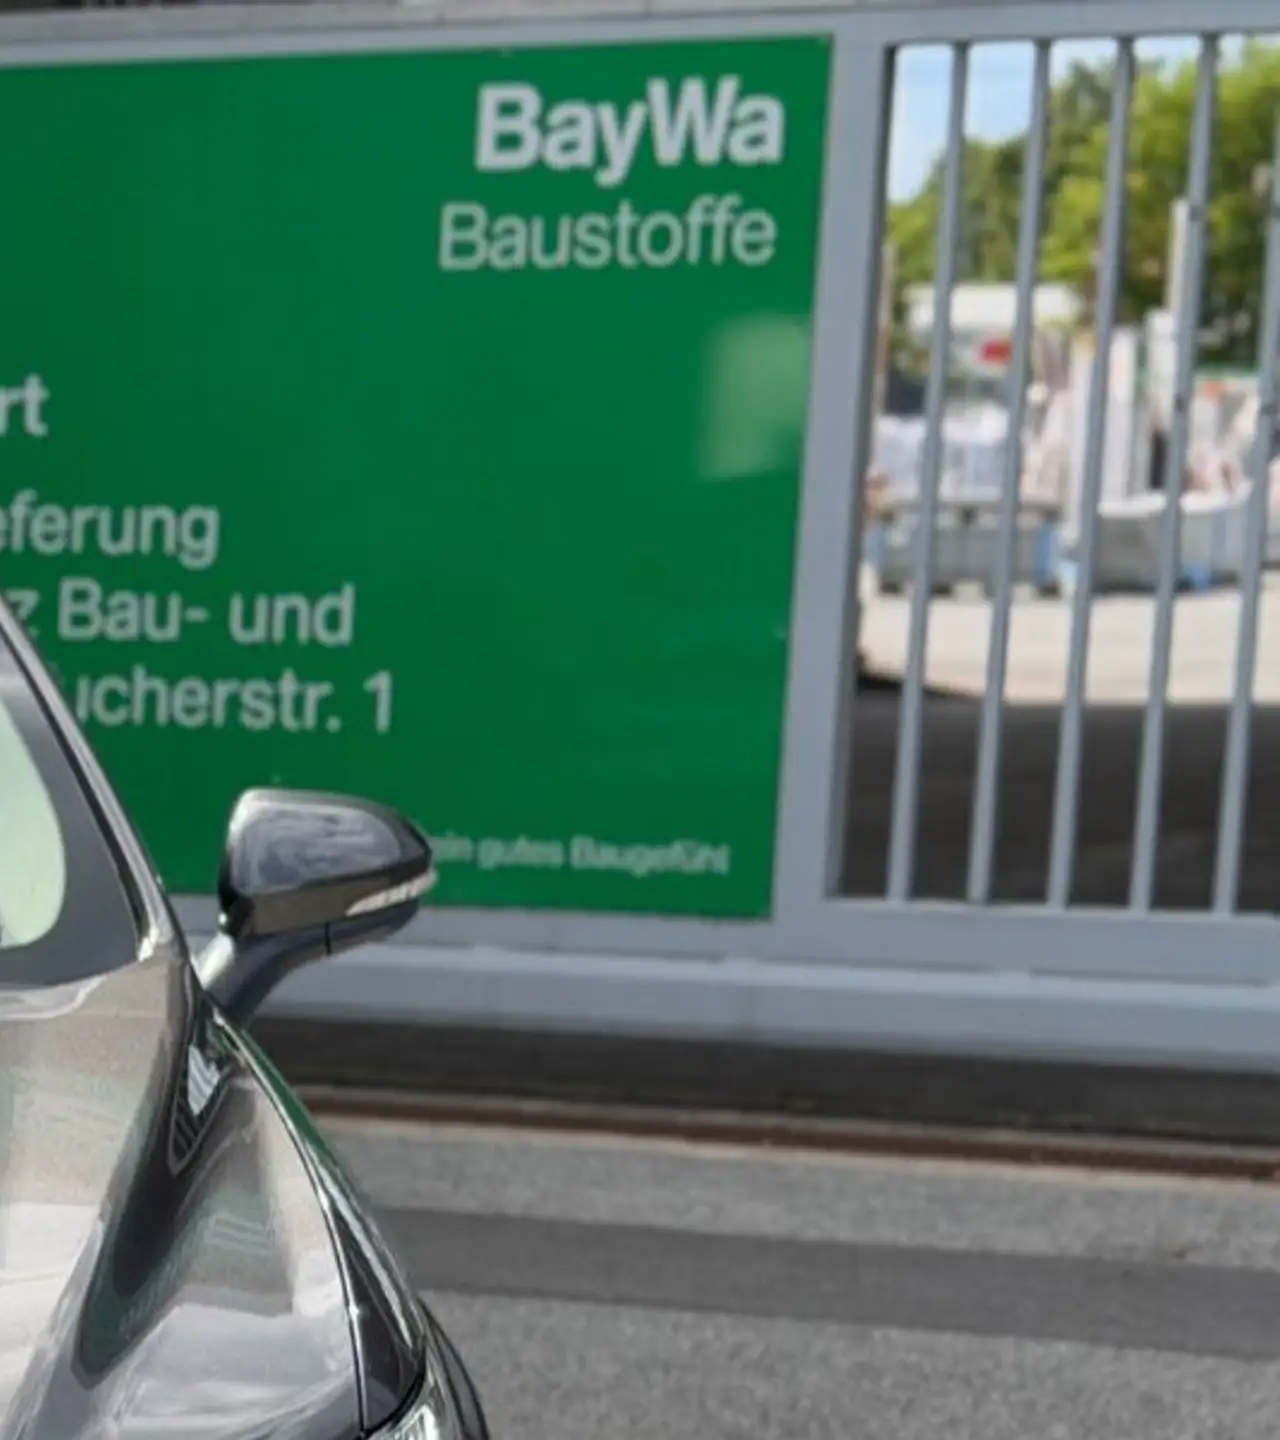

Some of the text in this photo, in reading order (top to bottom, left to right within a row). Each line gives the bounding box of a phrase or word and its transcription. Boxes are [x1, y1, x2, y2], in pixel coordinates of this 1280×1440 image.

[475, 75, 786, 187] BayWa
[439, 194, 776, 271] Baustoffe
[58, 577, 209, 643] Bau-
[229, 582, 355, 646] und
[363, 670, 393, 733] 1
